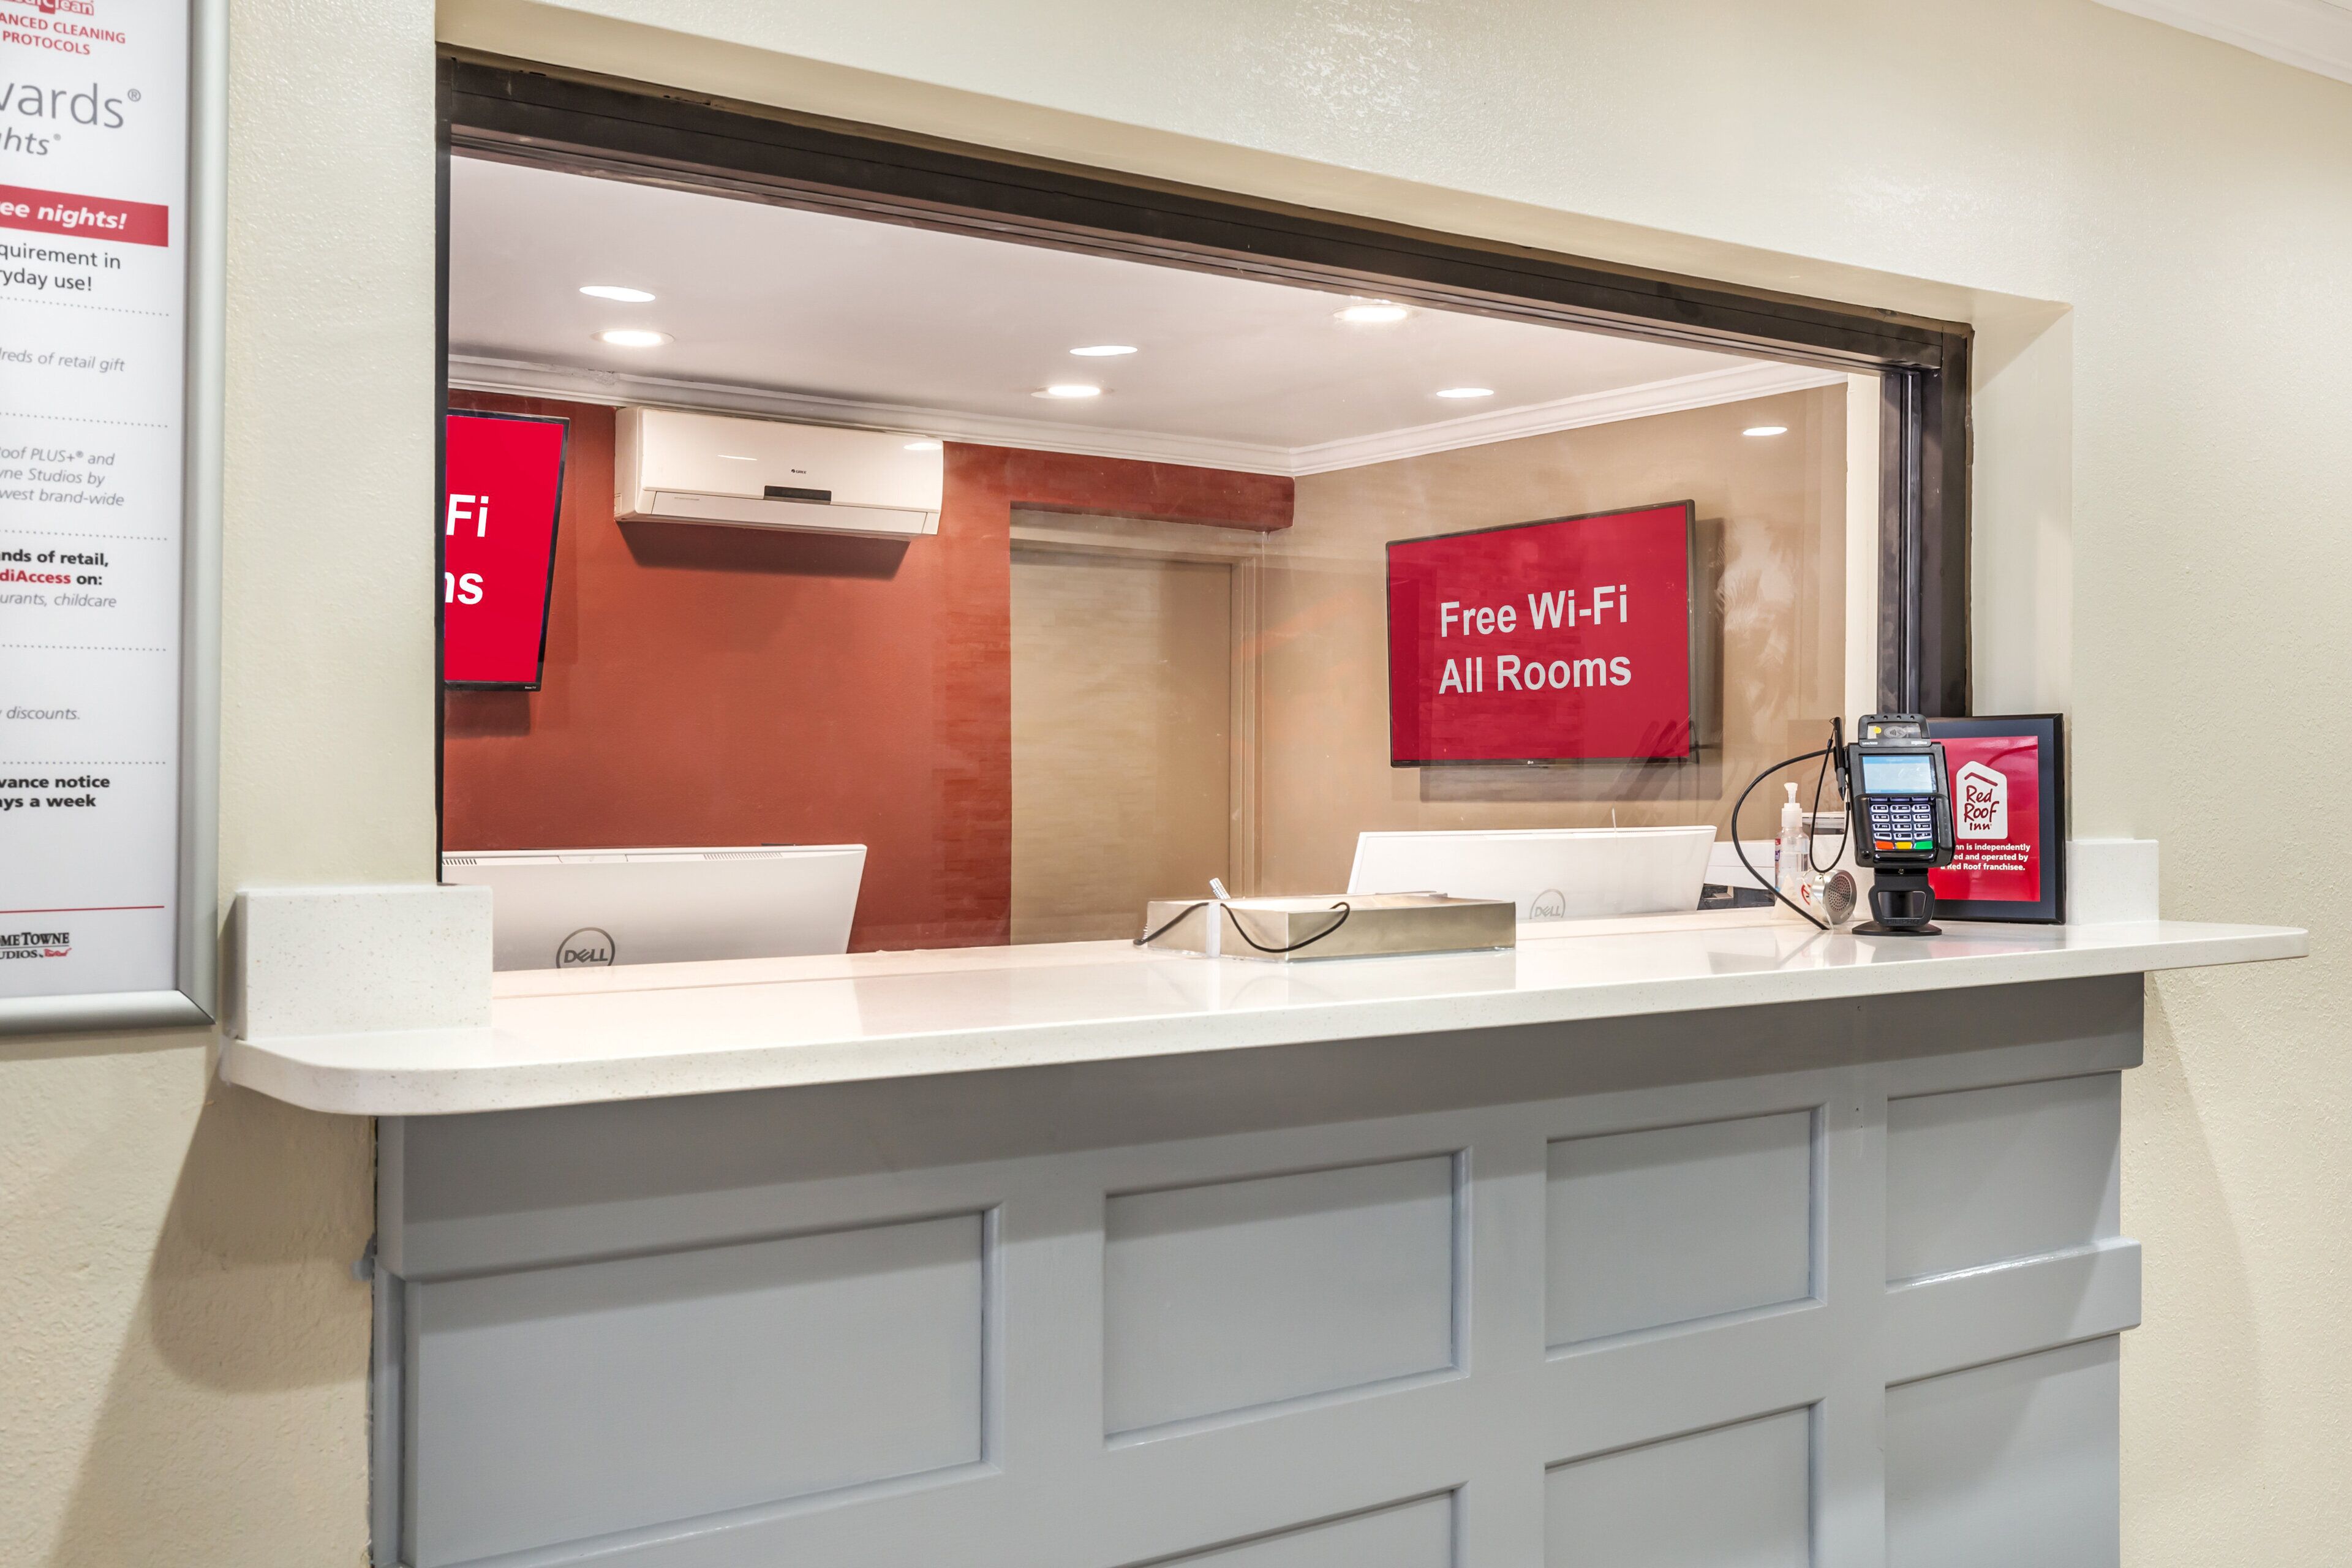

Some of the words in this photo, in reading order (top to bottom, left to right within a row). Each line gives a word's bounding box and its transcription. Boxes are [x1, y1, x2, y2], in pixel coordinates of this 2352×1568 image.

[0, 12, 48, 30] ANCED
[53, 22, 126, 44] CLEANING
[2, 31, 91, 55] PROTOCOLS
[37, 204, 127, 230] nights!
[0, 243, 98, 267] quirement
[104, 252, 121, 270] in
[55, 276, 92, 292] use!
[37, 352, 56, 365] of
[58, 356, 96, 369] retail
[99, 358, 126, 374] gift
[0, 446, 28, 459] oof
[87, 453, 116, 466] and
[28, 467, 83, 484] Studios
[86, 471, 105, 488] by
[39, 488, 125, 507] brand-wide
[0, 549, 32, 563] nds
[37, 550, 56, 564] of
[60, 552, 109, 568] retail,
[0, 568, 72, 584] diAccess
[76, 575, 103, 586] on:
[53, 592, 117, 608] childcare
[1441, 601, 1517, 638] Free
[1528, 584, 1627, 630] Wi-Fi
[1438, 657, 1483, 695] All
[1496, 654, 1632, 692] Rooms
[6, 706, 81, 720] discounts.
[55, 774, 111, 789] notice
[29, 797, 41, 808] a
[46, 793, 97, 808] week
[1966, 785, 1993, 804] Red
[1964, 801, 2000, 823] Roof
[1974, 843, 2031, 853] independently
[1981, 853, 2017, 862] operated
[2018, 853, 2029, 862] by
[1983, 862, 2026, 871] franchisee.
[1534, 905, 1561, 918] DELL
[564, 948, 608, 964] DELL
